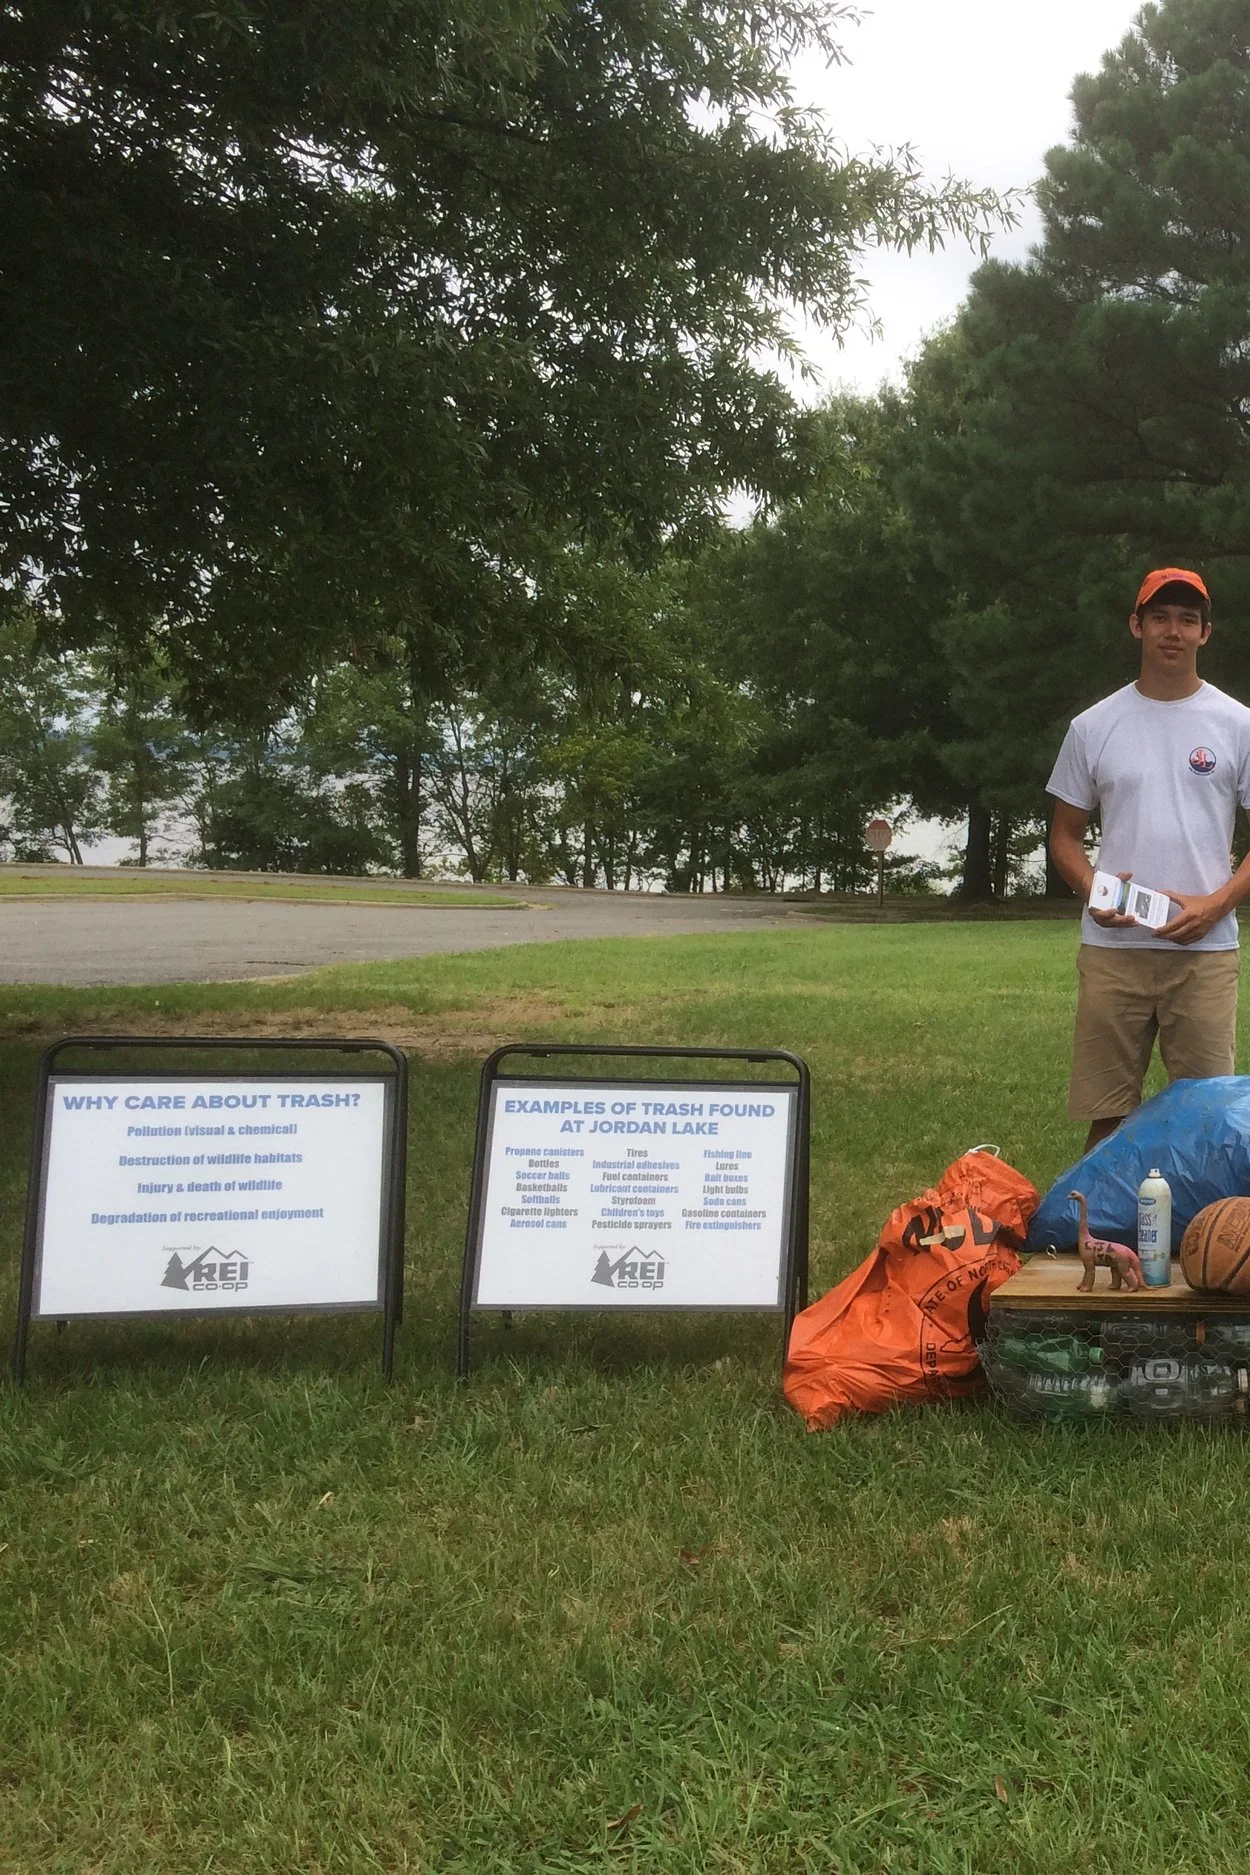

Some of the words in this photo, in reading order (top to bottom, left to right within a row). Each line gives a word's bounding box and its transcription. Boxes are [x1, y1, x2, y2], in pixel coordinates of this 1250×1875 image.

[62, 1095, 119, 1110] WHY
[124, 1095, 186, 1110] CARE
[191, 1094, 271, 1109] ABOUT
[277, 1093, 361, 1108] TRASH?
[504, 1099, 606, 1115] EXAMPLES
[610, 1101, 637, 1115] OF
[641, 1102, 703, 1116] TRASH
[708, 1103, 775, 1117] FOUND
[127, 1125, 182, 1137] Pollution
[227, 1126, 236, 1135] &
[559, 1119, 585, 1133] AT
[588, 1120, 667, 1134] JORDAN
[671, 1121, 719, 1135] LAKE
[504, 1146, 542, 1156] Propane
[542, 1147, 584, 1156] canisters
[626, 1148, 648, 1157] Tires
[703, 1149, 734, 1159] Fishing
[735, 1150, 752, 1159] line
[118, 1154, 190, 1166] Destruction
[192, 1154, 205, 1165] of
[206, 1153, 252, 1165] wildlife
[253, 1152, 303, 1164] habitats
[528, 1158, 559, 1168] Bottles
[592, 1159, 635, 1169] Industrial
[635, 1160, 680, 1170] adhesives
[715, 1161, 739, 1170] Lures
[515, 1170, 547, 1180] Soccer
[548, 1171, 570, 1180] balls
[602, 1171, 620, 1181] Fuel
[621, 1172, 668, 1181] containers
[704, 1173, 721, 1182] Bait
[722, 1173, 748, 1182] boxes
[137, 1182, 174, 1194] Injury
[175, 1183, 184, 1193] &
[186, 1180, 222, 1192] death
[223, 1180, 236, 1191] of
[237, 1179, 282, 1191] wildlife
[515, 1182, 568, 1192] Basketballs
[590, 1183, 631, 1193] Lubricant
[632, 1185, 679, 1193] containers
[702, 1184, 723, 1195] Light
[724, 1185, 748, 1194] bulbs
[521, 1194, 560, 1204] Softballs
[611, 1195, 656, 1206] Styrofoam
[703, 1196, 724, 1206] Soda
[726, 1198, 747, 1206] cans
[91, 1212, 167, 1225] Degradation
[169, 1211, 182, 1222] of
[183, 1209, 259, 1222] recreational
[261, 1207, 324, 1220] enjoyment
[500, 1206, 543, 1217] Cigarette
[544, 1207, 578, 1217] lighters
[600, 1207, 645, 1217] Children's
[646, 1209, 664, 1218] toys
[681, 1208, 719, 1218] Gasoline
[720, 1209, 766, 1218] containers
[509, 1218, 544, 1228] Aerosol
[545, 1220, 567, 1228] cans
[591, 1219, 632, 1229] Pesticide
[633, 1221, 672, 1230] sprayers
[685, 1220, 701, 1230] Fire
[702, 1220, 761, 1231] extinguishers
[193, 1262, 249, 1282] REI
[618, 1262, 665, 1280] REI
[924, 1291, 946, 1314] ATE
[946, 1275, 965, 1292] OF
[925, 1342, 938, 1378] DEPA
